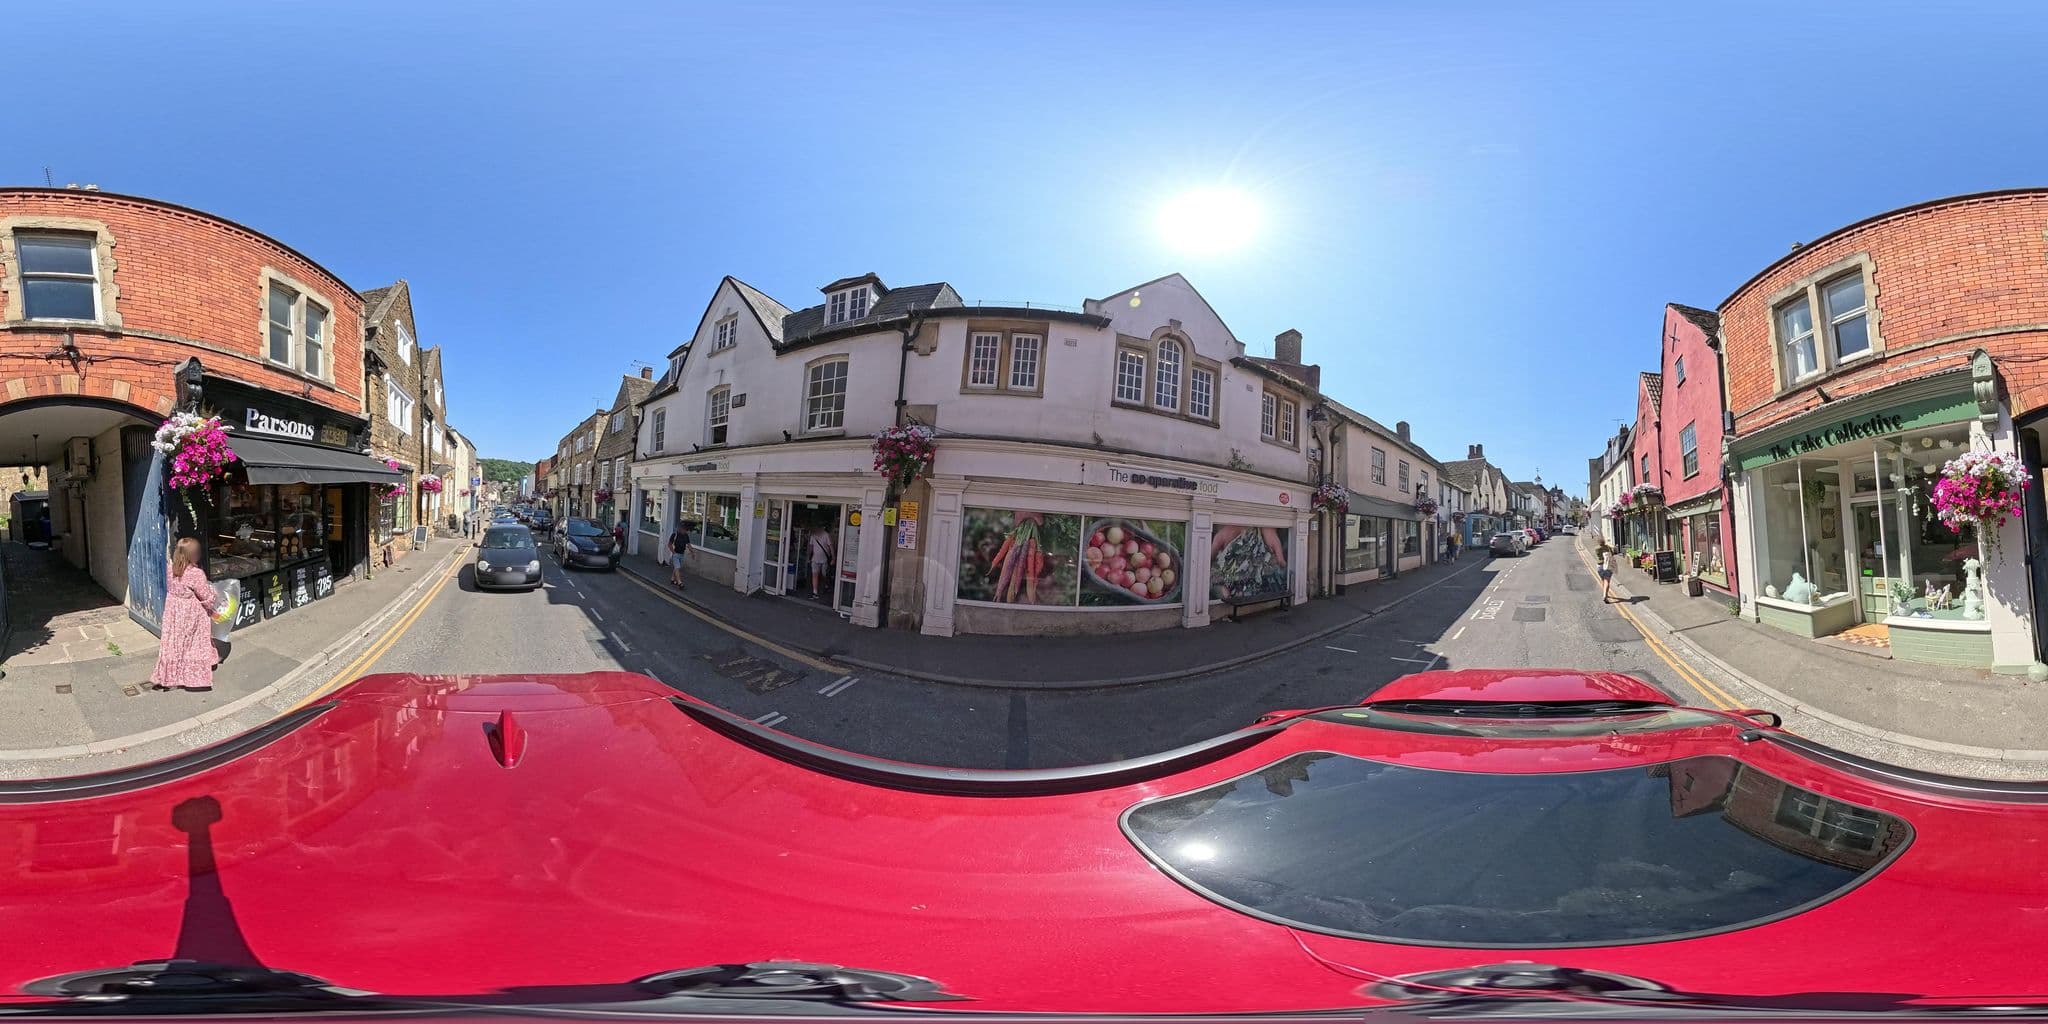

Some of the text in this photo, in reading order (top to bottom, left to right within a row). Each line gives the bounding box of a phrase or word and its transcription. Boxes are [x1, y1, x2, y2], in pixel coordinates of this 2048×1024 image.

[245, 407, 315, 441] Parsons
[1770, 414, 1903, 460] The Cake Collective
[1110, 468, 1129, 483] The
[1199, 481, 1218, 493] food
